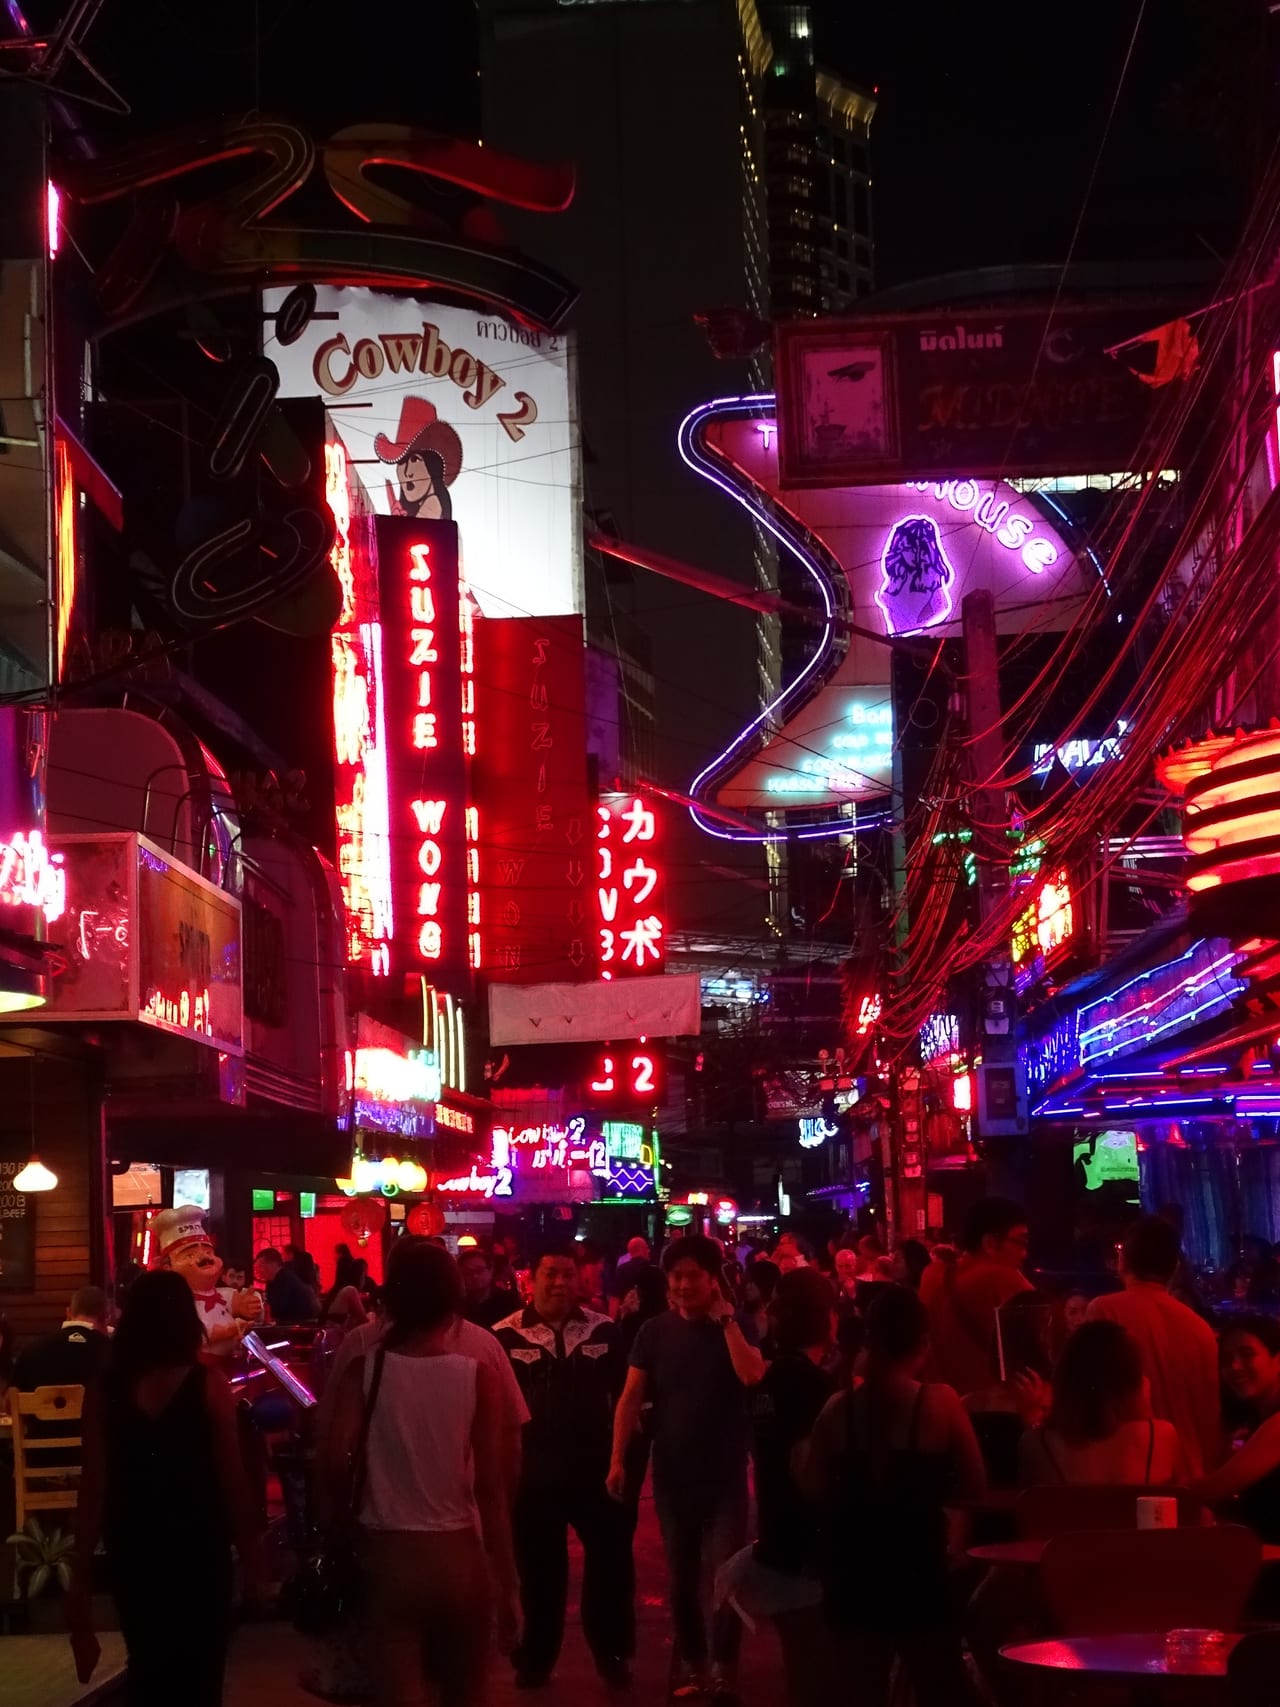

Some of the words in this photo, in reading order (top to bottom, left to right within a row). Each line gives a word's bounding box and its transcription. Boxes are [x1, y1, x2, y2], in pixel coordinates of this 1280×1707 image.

[312, 321, 506, 409] Cowboy
[496, 391, 538, 443] 2
[408, 543, 438, 750] SUZIE
[529, 638, 554, 832] SUZIE
[410, 800, 447, 960] WONG
[498, 858, 526, 972] WON
[619, 798, 663, 967] カウボ
[631, 1056, 656, 1092] 2
